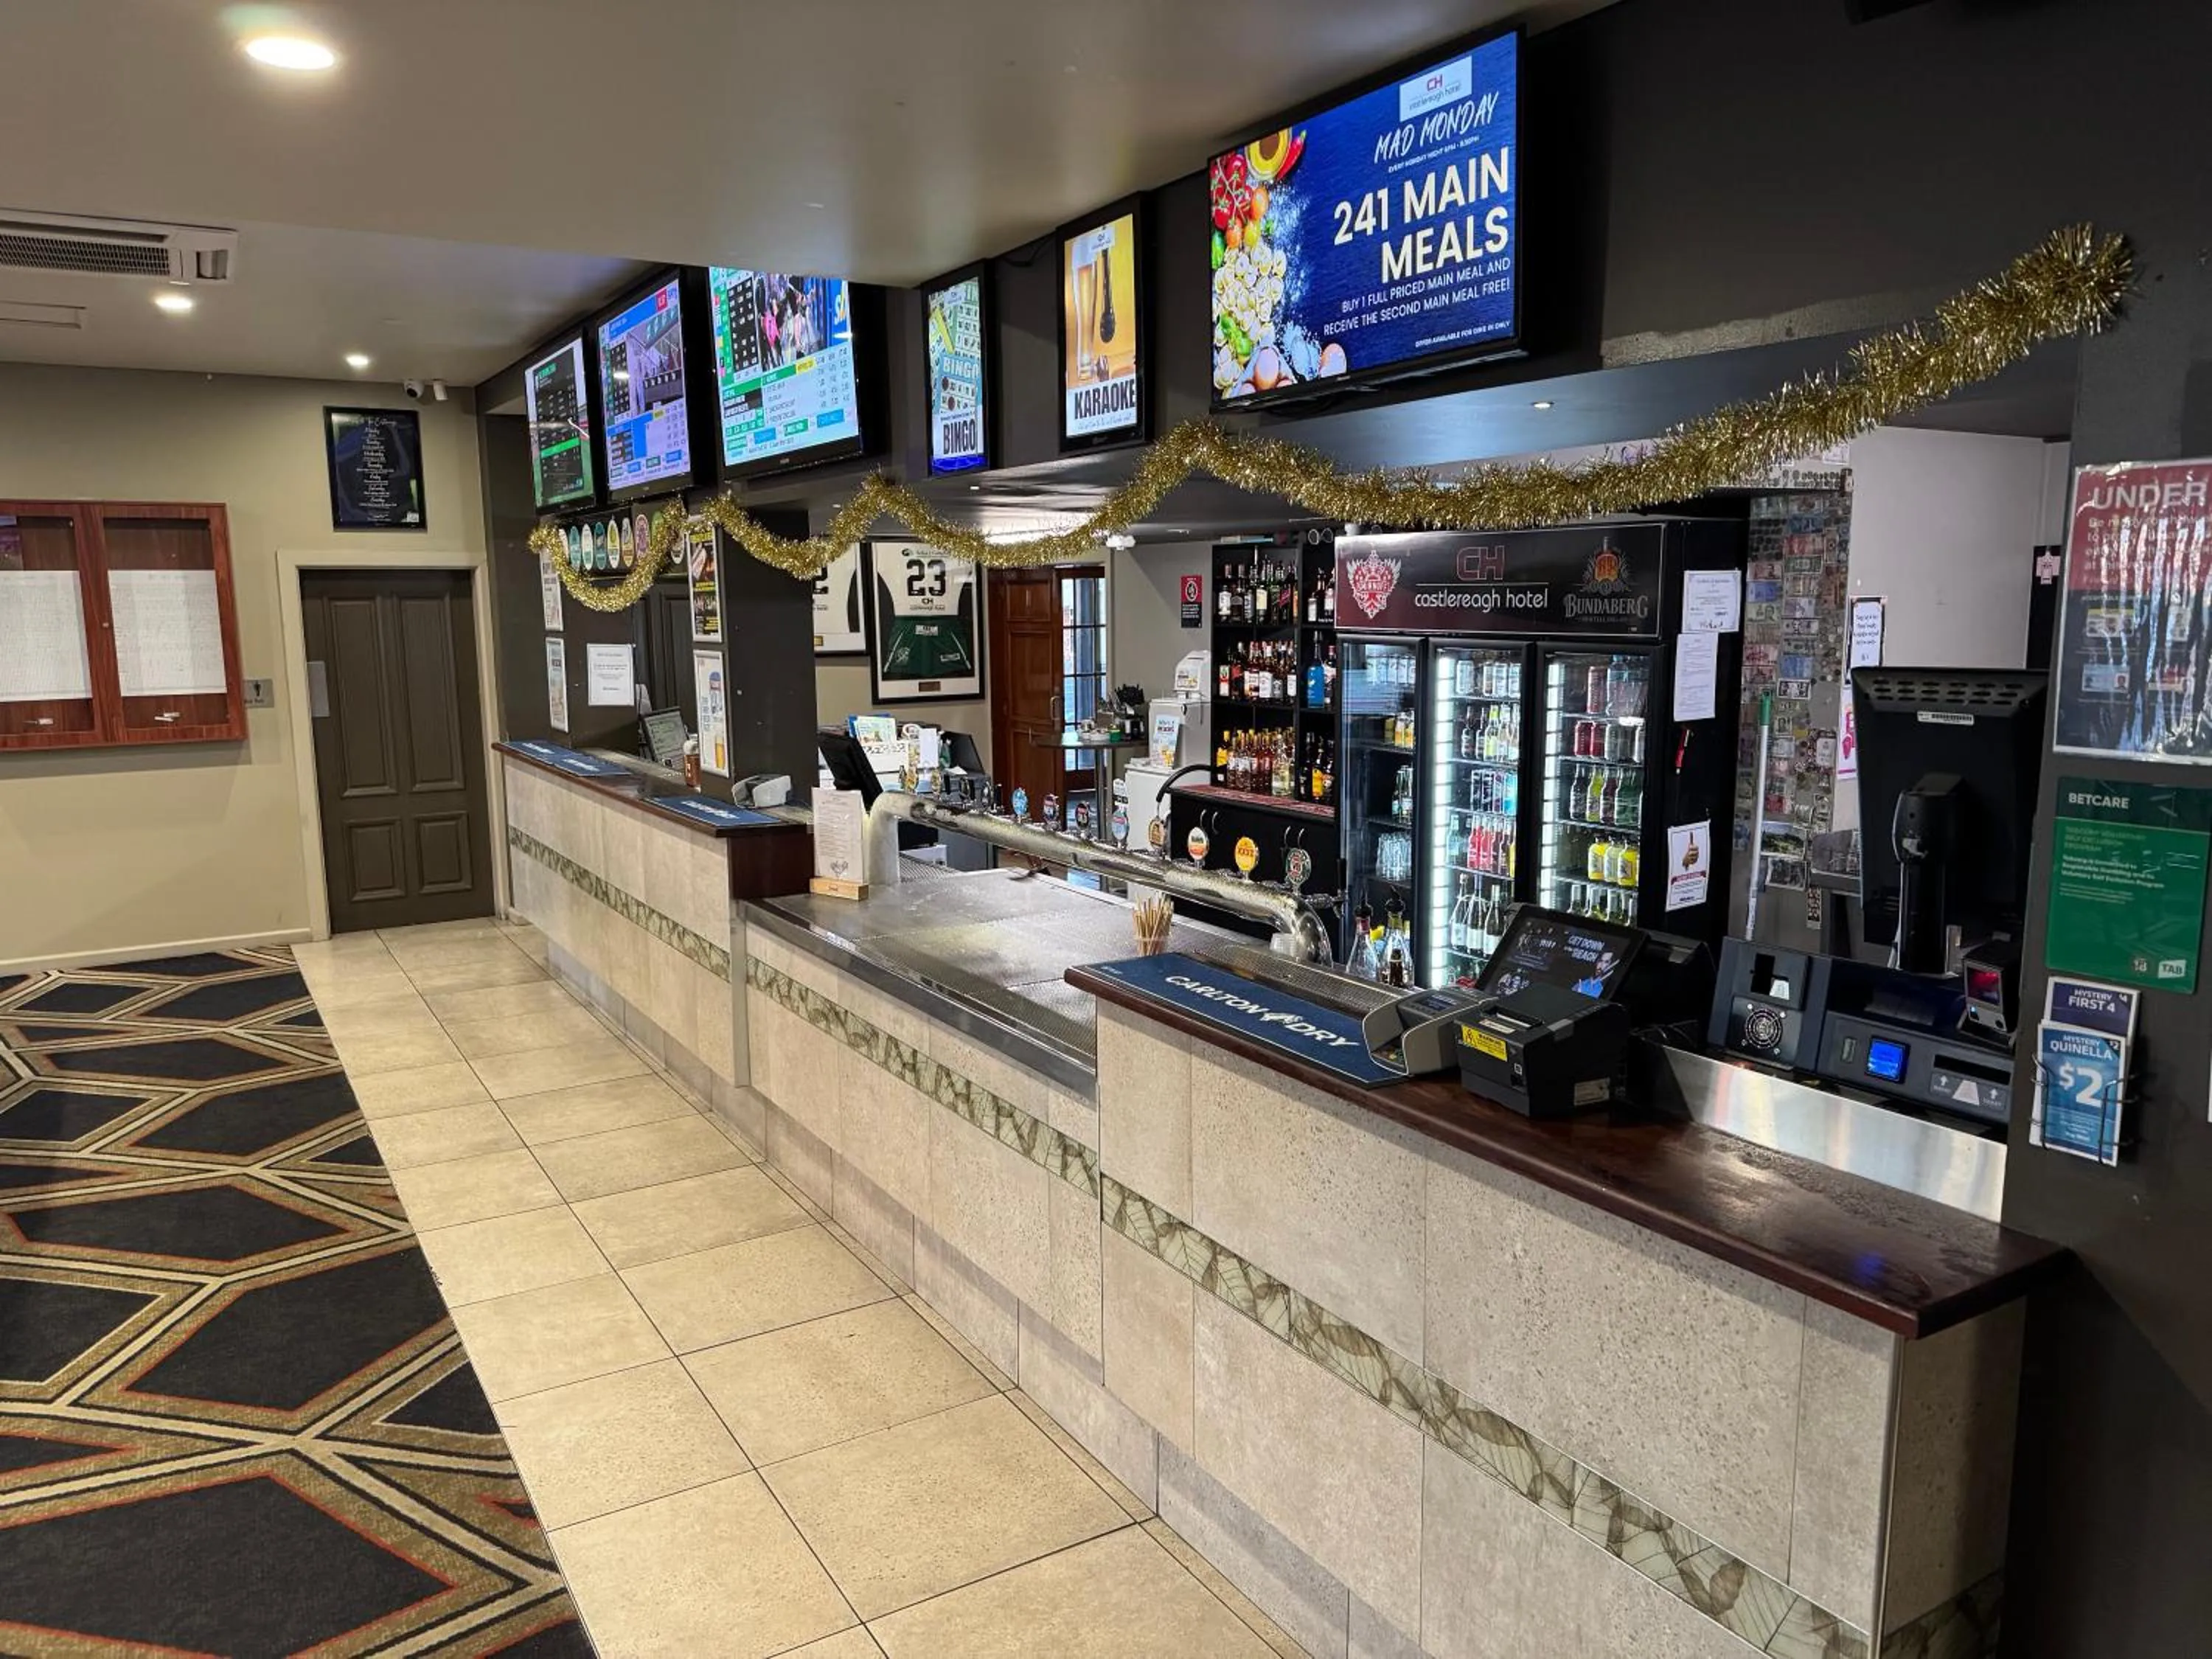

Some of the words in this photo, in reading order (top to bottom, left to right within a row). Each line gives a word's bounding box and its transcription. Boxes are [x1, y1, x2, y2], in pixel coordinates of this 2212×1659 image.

[1427, 74, 1443, 91] CH
[1374, 124, 1415, 164] MAD
[1419, 91, 1499, 147] MONDAY
[1333, 188, 1391, 246] 241
[1404, 147, 1509, 223] MAIN
[1381, 206, 1509, 284] MEALS
[1341, 299, 1359, 313] BUY
[1368, 291, 1388, 306] FULL
[1391, 281, 1425, 300] PRICED
[1427, 273, 1453, 289] MAIN
[1456, 266, 1484, 282] MEAL
[1486, 257, 1511, 274] AND
[1324, 316, 1359, 335] RECEIVE
[1362, 311, 1378, 326] THE
[1380, 302, 1421, 321] SECOND
[1424, 293, 1449, 311] MAIN
[1452, 287, 1479, 303] MEAL
[1482, 277, 1511, 296] FREE!
[1074, 378, 1135, 420] KARAOKE
[943, 419, 975, 454] BINGO
[2092, 481, 2208, 509] UNDER
[907, 559, 946, 597] 23
[1456, 545, 1505, 581] CH
[1415, 588, 1500, 613] castlereagh
[1506, 588, 1548, 608] hotel
[1564, 594, 1648, 619] BUNDABERG
[2068, 792, 2130, 809] BETCARE
[2162, 963, 2183, 974] TAB
[1165, 975, 1264, 1014] CARLTON
[1284, 1020, 1360, 1046] DRY
[2067, 995, 2105, 1011] FIRST
[2108, 1002, 2116, 1013] 4
[2074, 988, 2112, 1001] MYSTERY
[2049, 1040, 2113, 1060] QUINELLA
[2062, 1034, 2101, 1046] MYSTERY
[2058, 1060, 2103, 1107] $2
